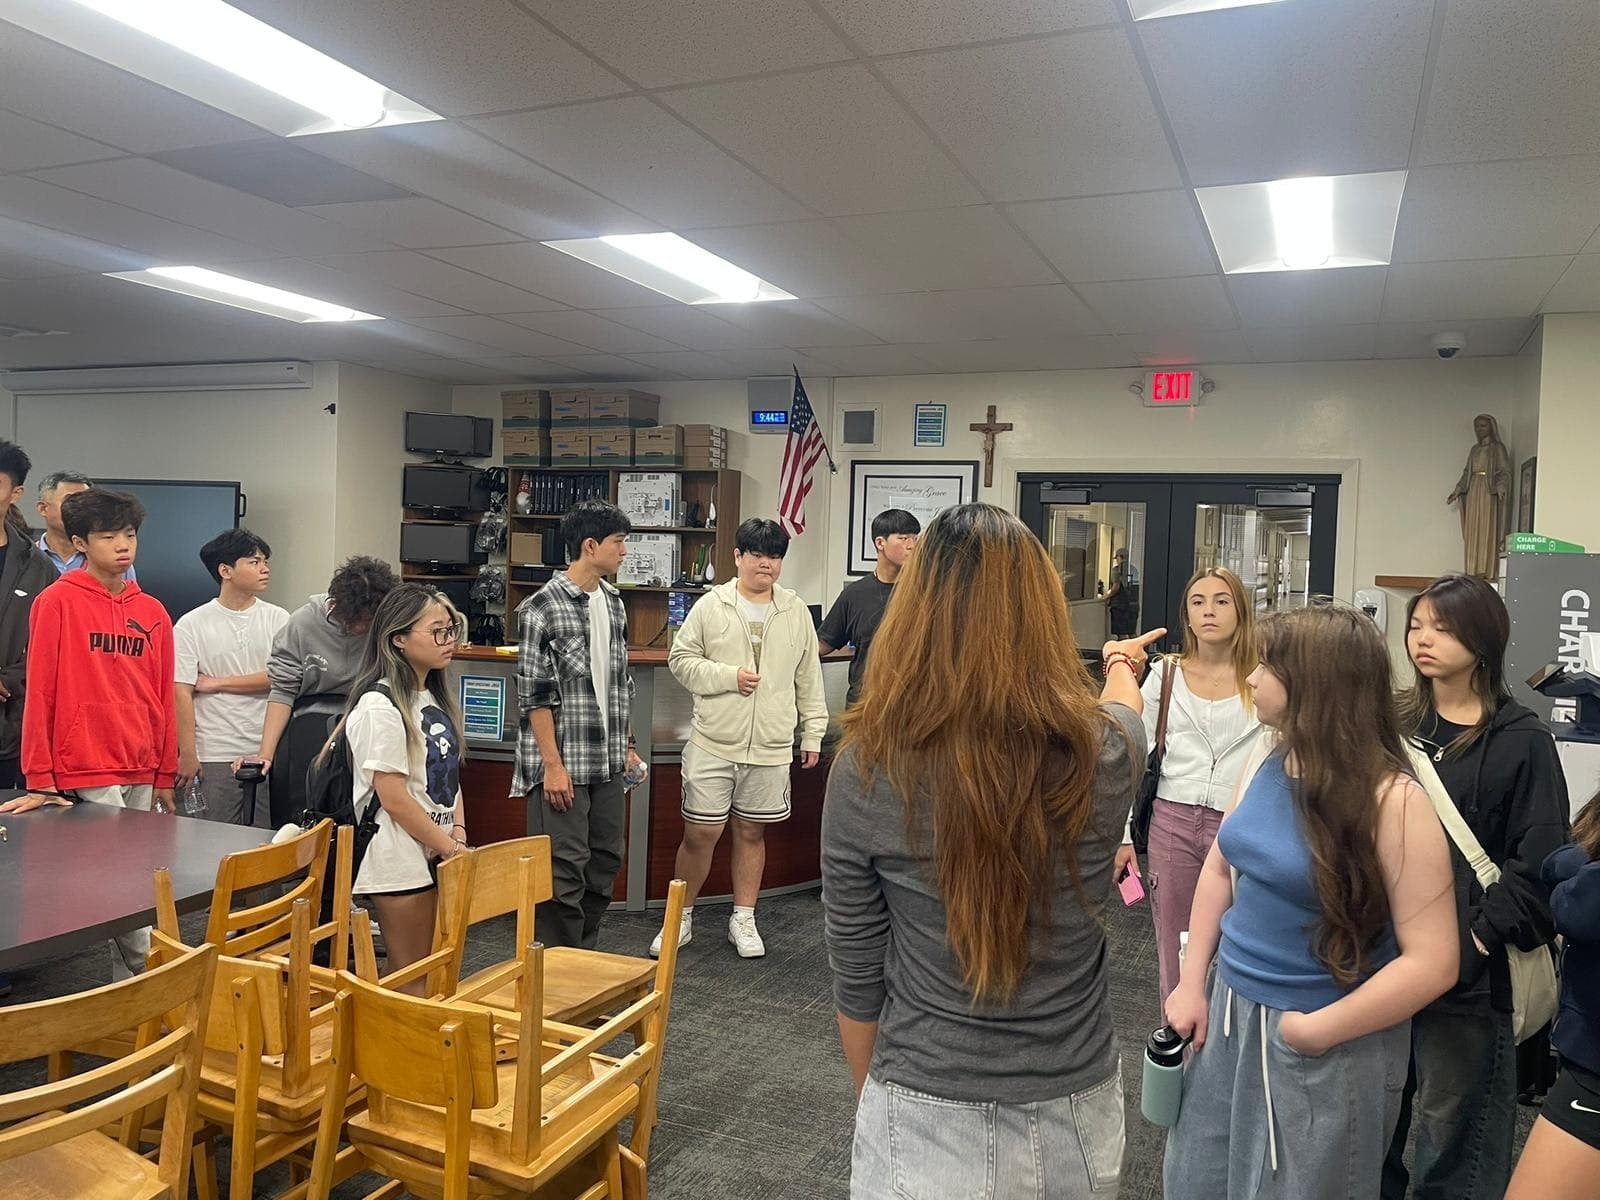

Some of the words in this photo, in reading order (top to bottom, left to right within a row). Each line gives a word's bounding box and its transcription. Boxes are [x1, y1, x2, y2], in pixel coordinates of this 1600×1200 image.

[1152, 371, 1192, 401] EXIT
[922, 486, 947, 498] Grace
[89, 632, 145, 657] PUMA
